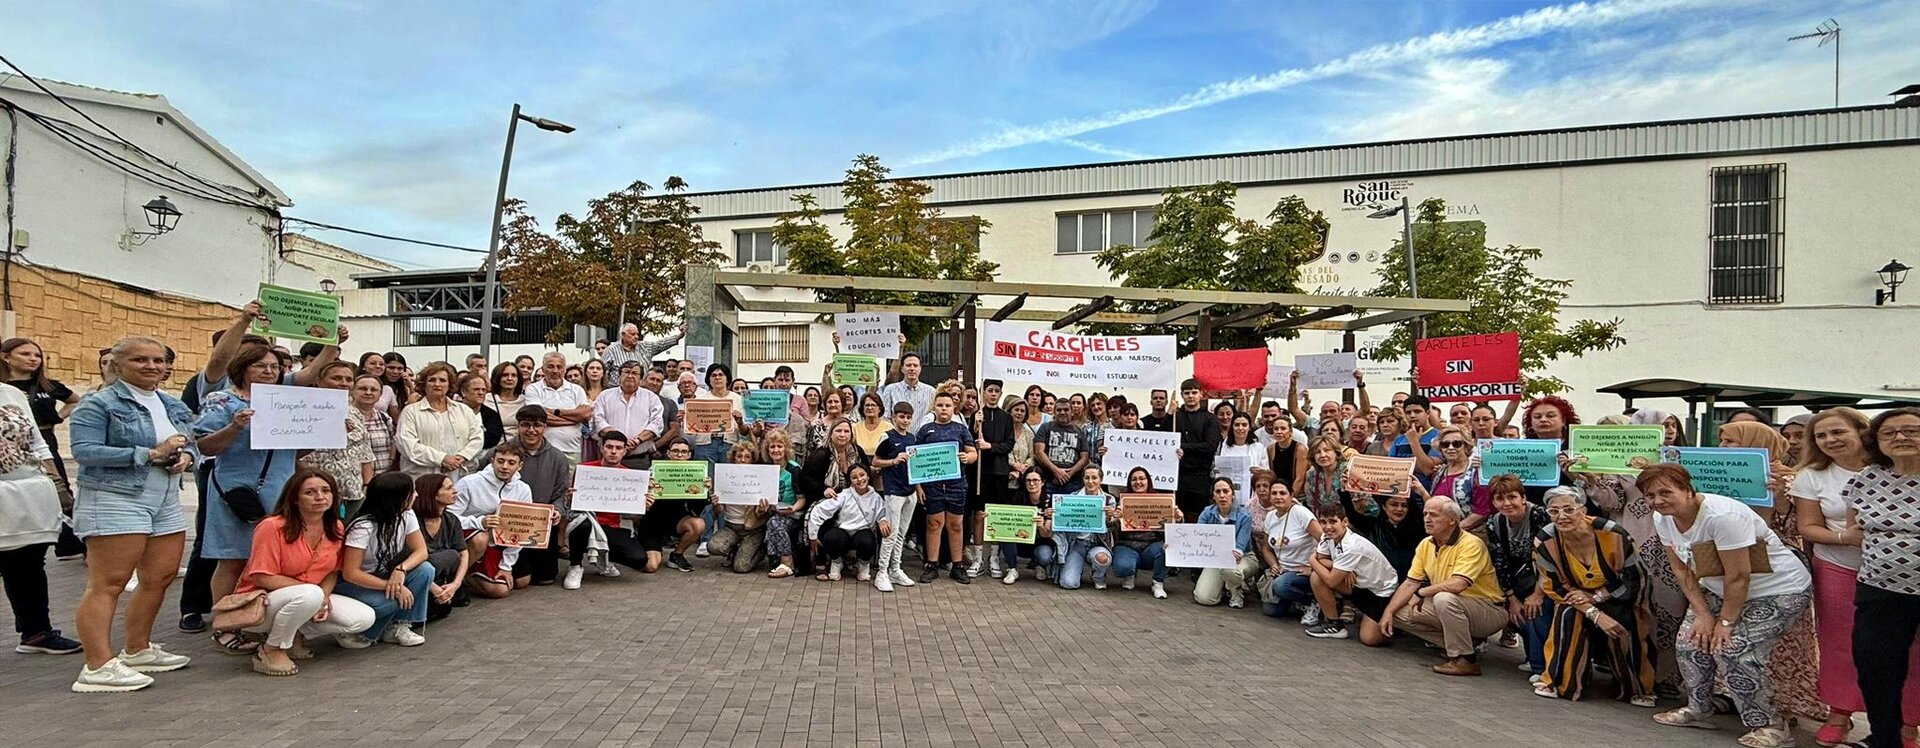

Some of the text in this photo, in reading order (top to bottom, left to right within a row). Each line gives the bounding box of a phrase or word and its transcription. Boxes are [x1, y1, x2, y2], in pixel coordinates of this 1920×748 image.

[1318, 266, 1333, 274] DEL
[1347, 287, 1359, 296] de
[310, 315, 335, 324] ESCOLAR
[846, 328, 882, 336] RECORTES
[997, 343, 1016, 356] SIN
[1092, 354, 1123, 362] ESCOLAR
[1129, 354, 1162, 363] NUESTROS
[1446, 360, 1473, 373] SIN
[1006, 367, 1032, 376] HIJOS
[1069, 372, 1098, 380] PUEDEN
[1106, 372, 1139, 380] ESTUDIAR
[1418, 383, 1521, 398] TRANSPORTE
[1107, 470, 1175, 483] PERJADO
[1690, 475, 1728, 483] ANSPORTE
